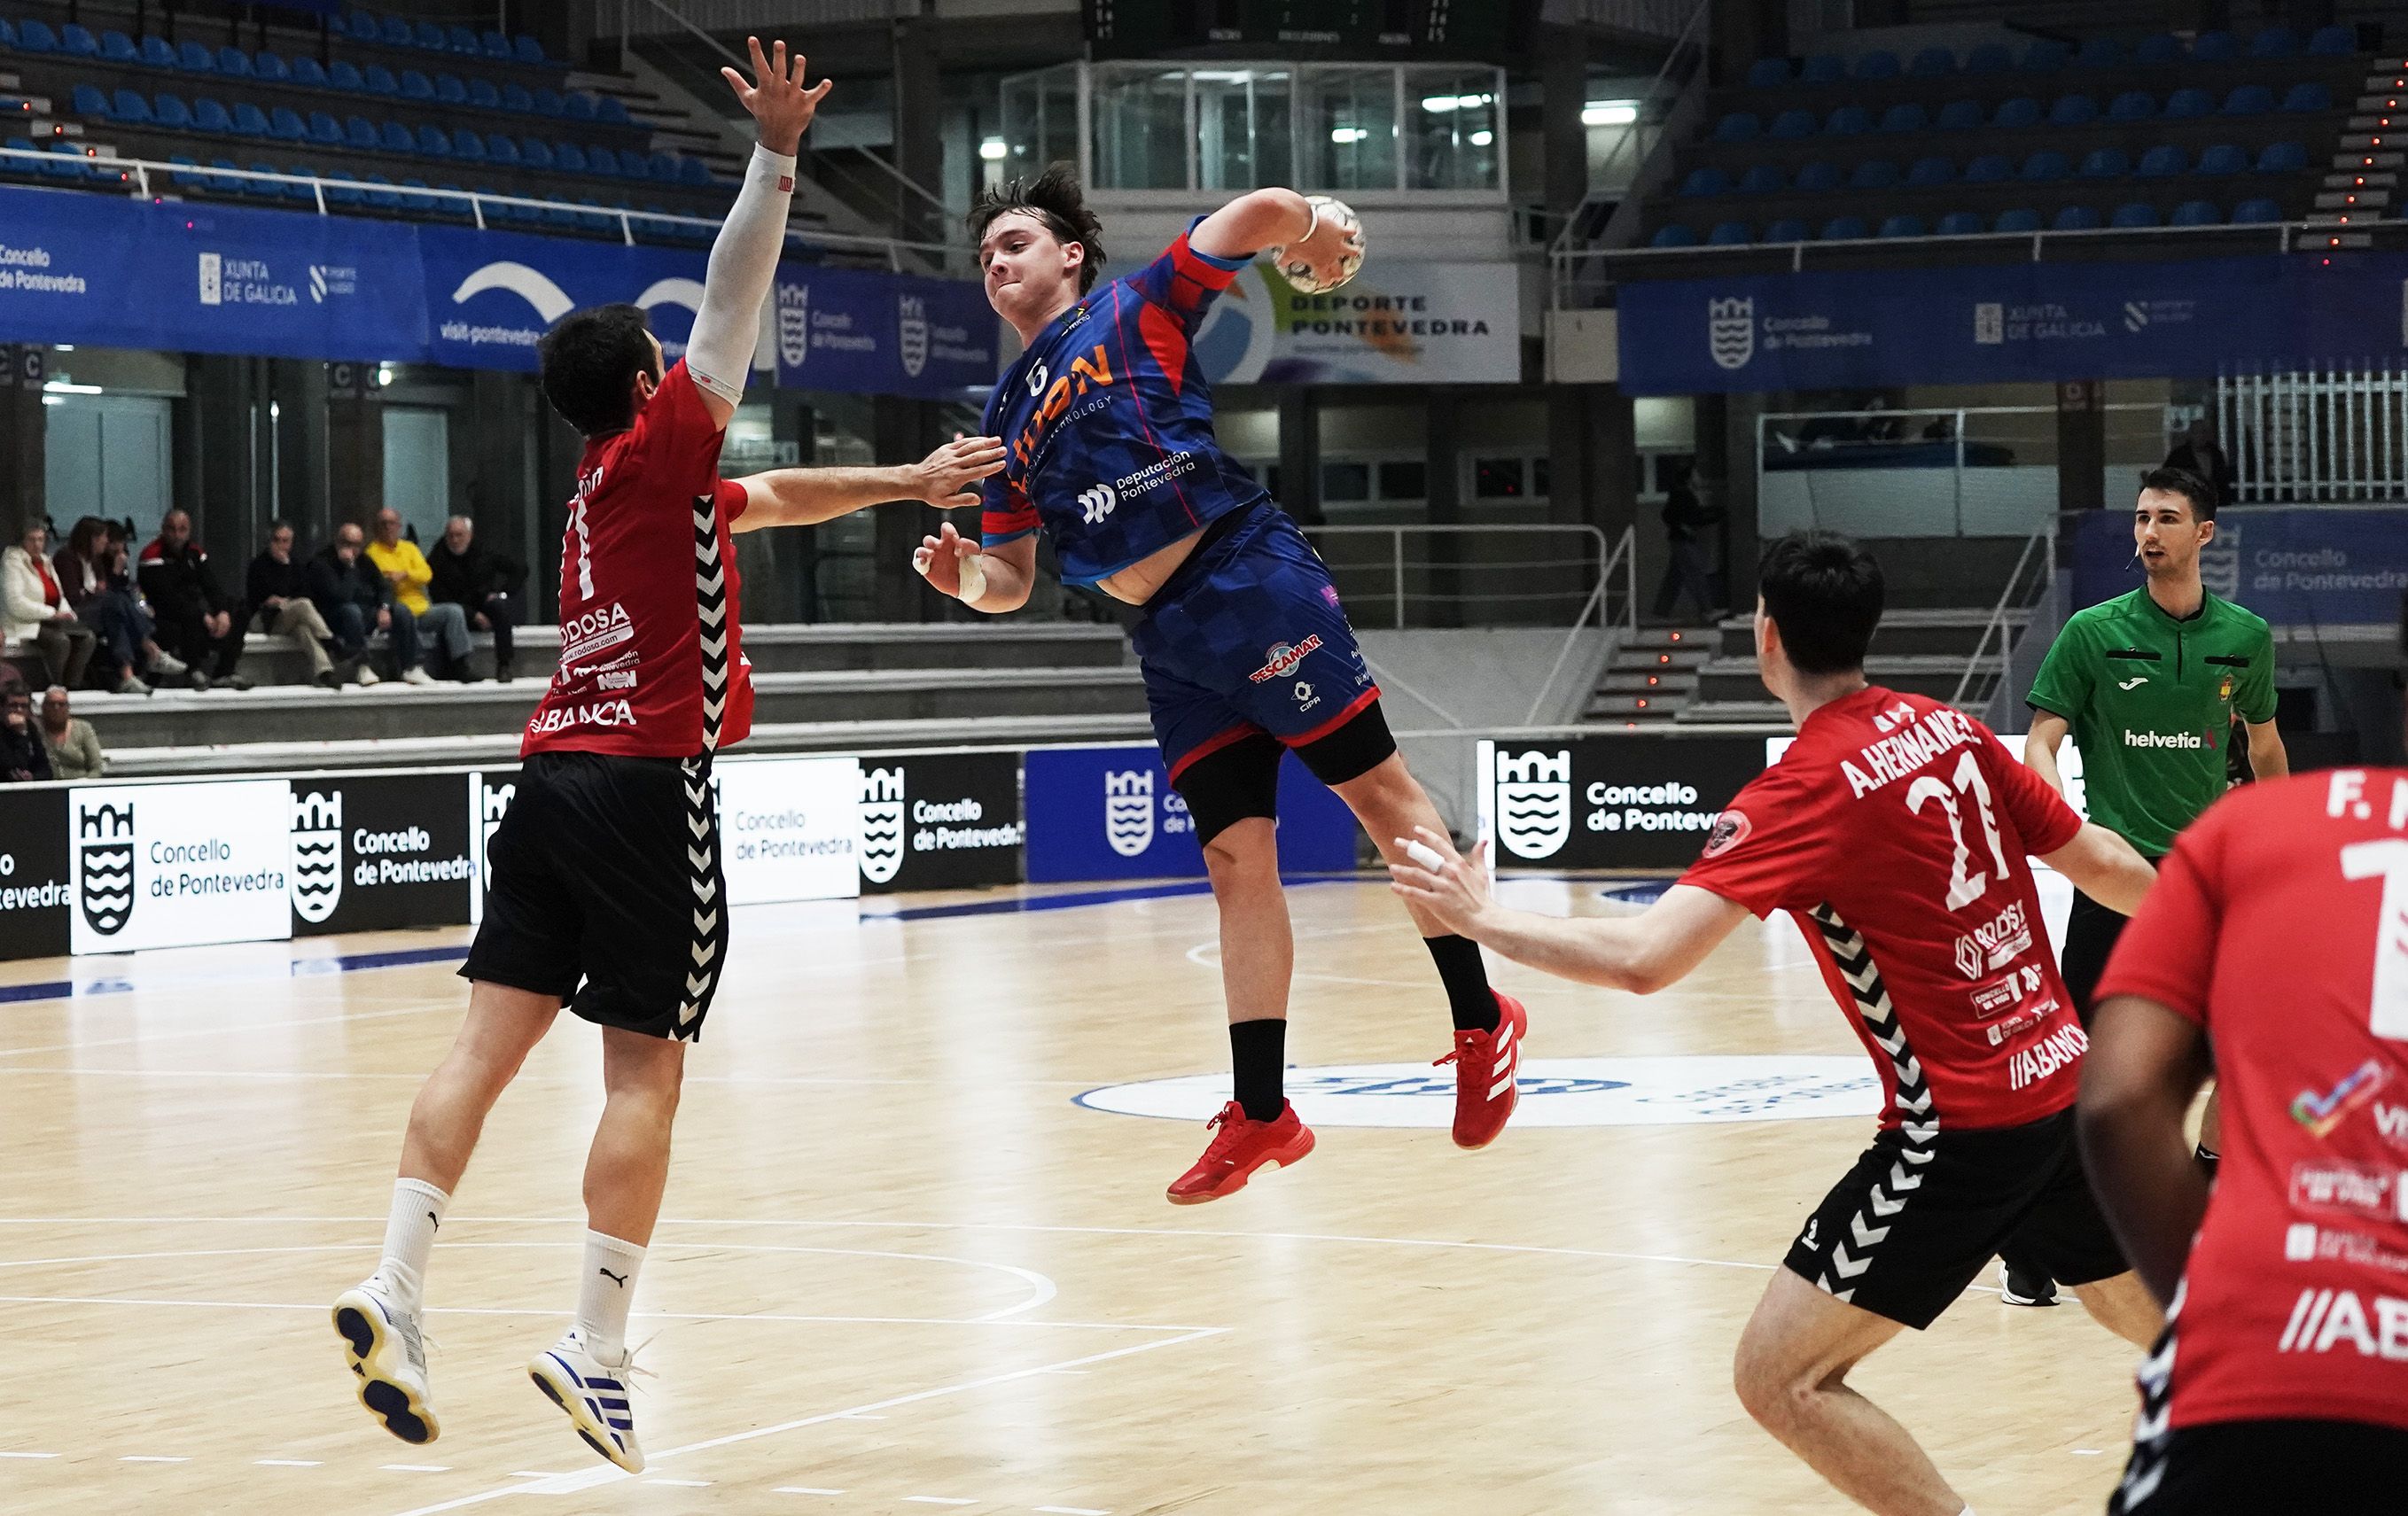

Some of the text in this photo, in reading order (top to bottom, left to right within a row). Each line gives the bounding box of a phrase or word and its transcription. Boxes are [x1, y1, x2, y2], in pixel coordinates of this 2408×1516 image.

[15, 269, 86, 294] Pontevedra
[224, 261, 269, 279] XUNTA
[224, 284, 298, 305] DE GALICIA
[1291, 295, 1427, 311] DEPORTE
[1291, 320, 1489, 336] PONTEVEDRA
[1117, 450, 1191, 490] Deputación
[1120, 462, 1196, 501] Pontevedra
[1250, 634, 1322, 683] PESCAMAR
[2124, 729, 2201, 750] helvetia
[1586, 782, 1698, 805] Concello
[2327, 770, 2372, 820] F.
[736, 810, 805, 831] Concello
[913, 797, 982, 824] Concello
[1586, 812, 1621, 831] de
[354, 826, 430, 853] Concello
[913, 828, 936, 851] de
[1905, 750, 2010, 912] 21
[151, 839, 230, 865] Concello
[736, 836, 853, 859] de Pontevedra
[354, 854, 476, 886] de Pontevedra
[151, 868, 284, 898] de Pontevedra
